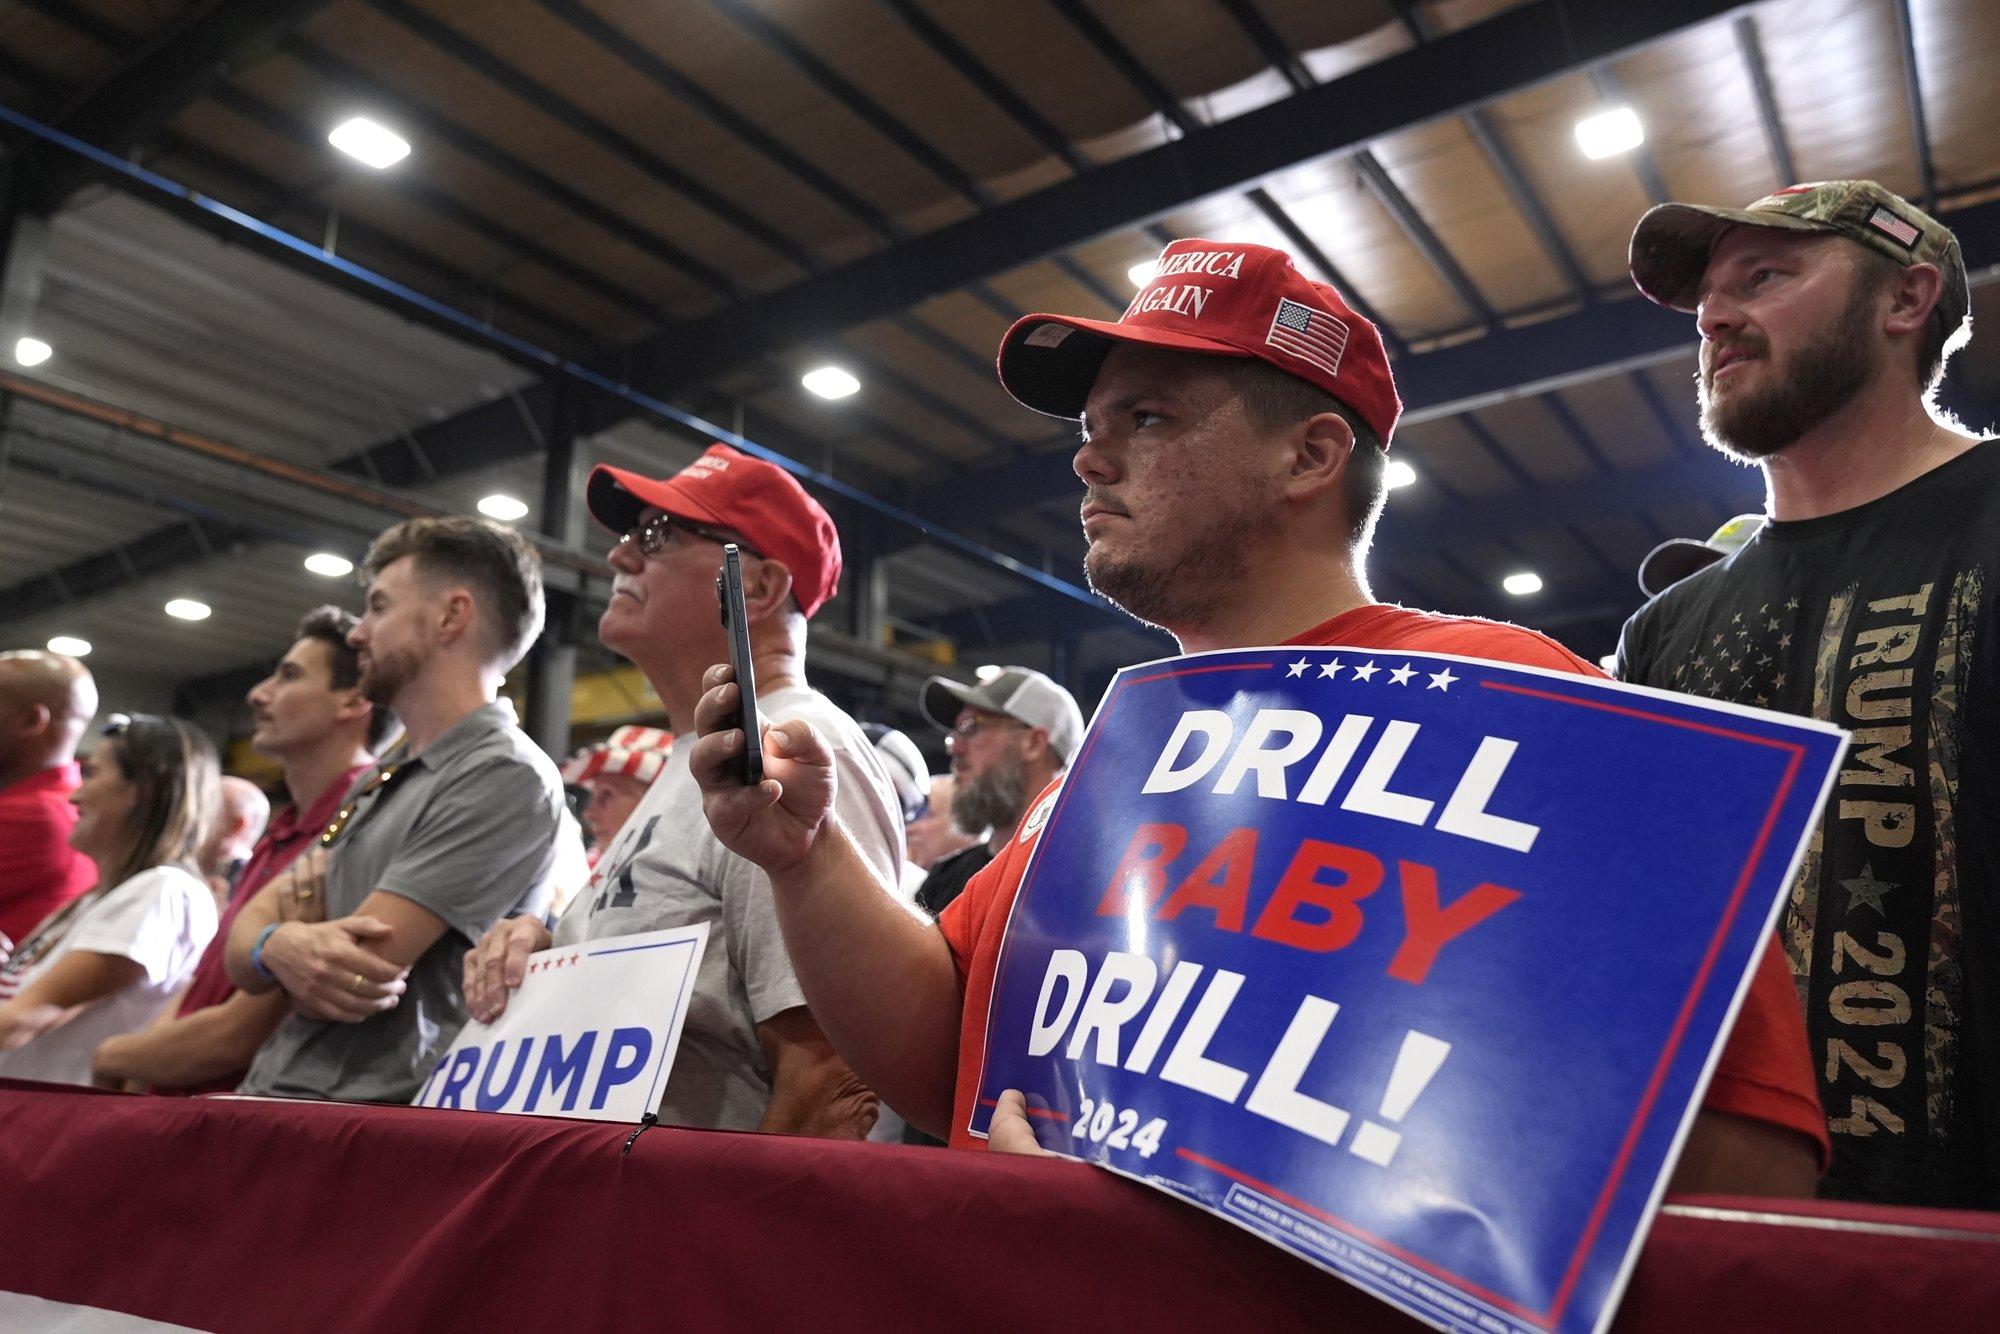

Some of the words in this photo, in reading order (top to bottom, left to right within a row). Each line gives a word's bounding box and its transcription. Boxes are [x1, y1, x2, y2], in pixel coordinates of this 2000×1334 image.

[1155, 251, 1246, 280] MERICA
[1140, 709, 1540, 853] DRILL
[1839, 583, 1934, 848] TRUMP
[1096, 822, 1522, 987] BABY
[1028, 949, 1451, 1167] DRILL!
[1825, 931, 1912, 1137] 2024
[1071, 1098, 1168, 1159] 2024
